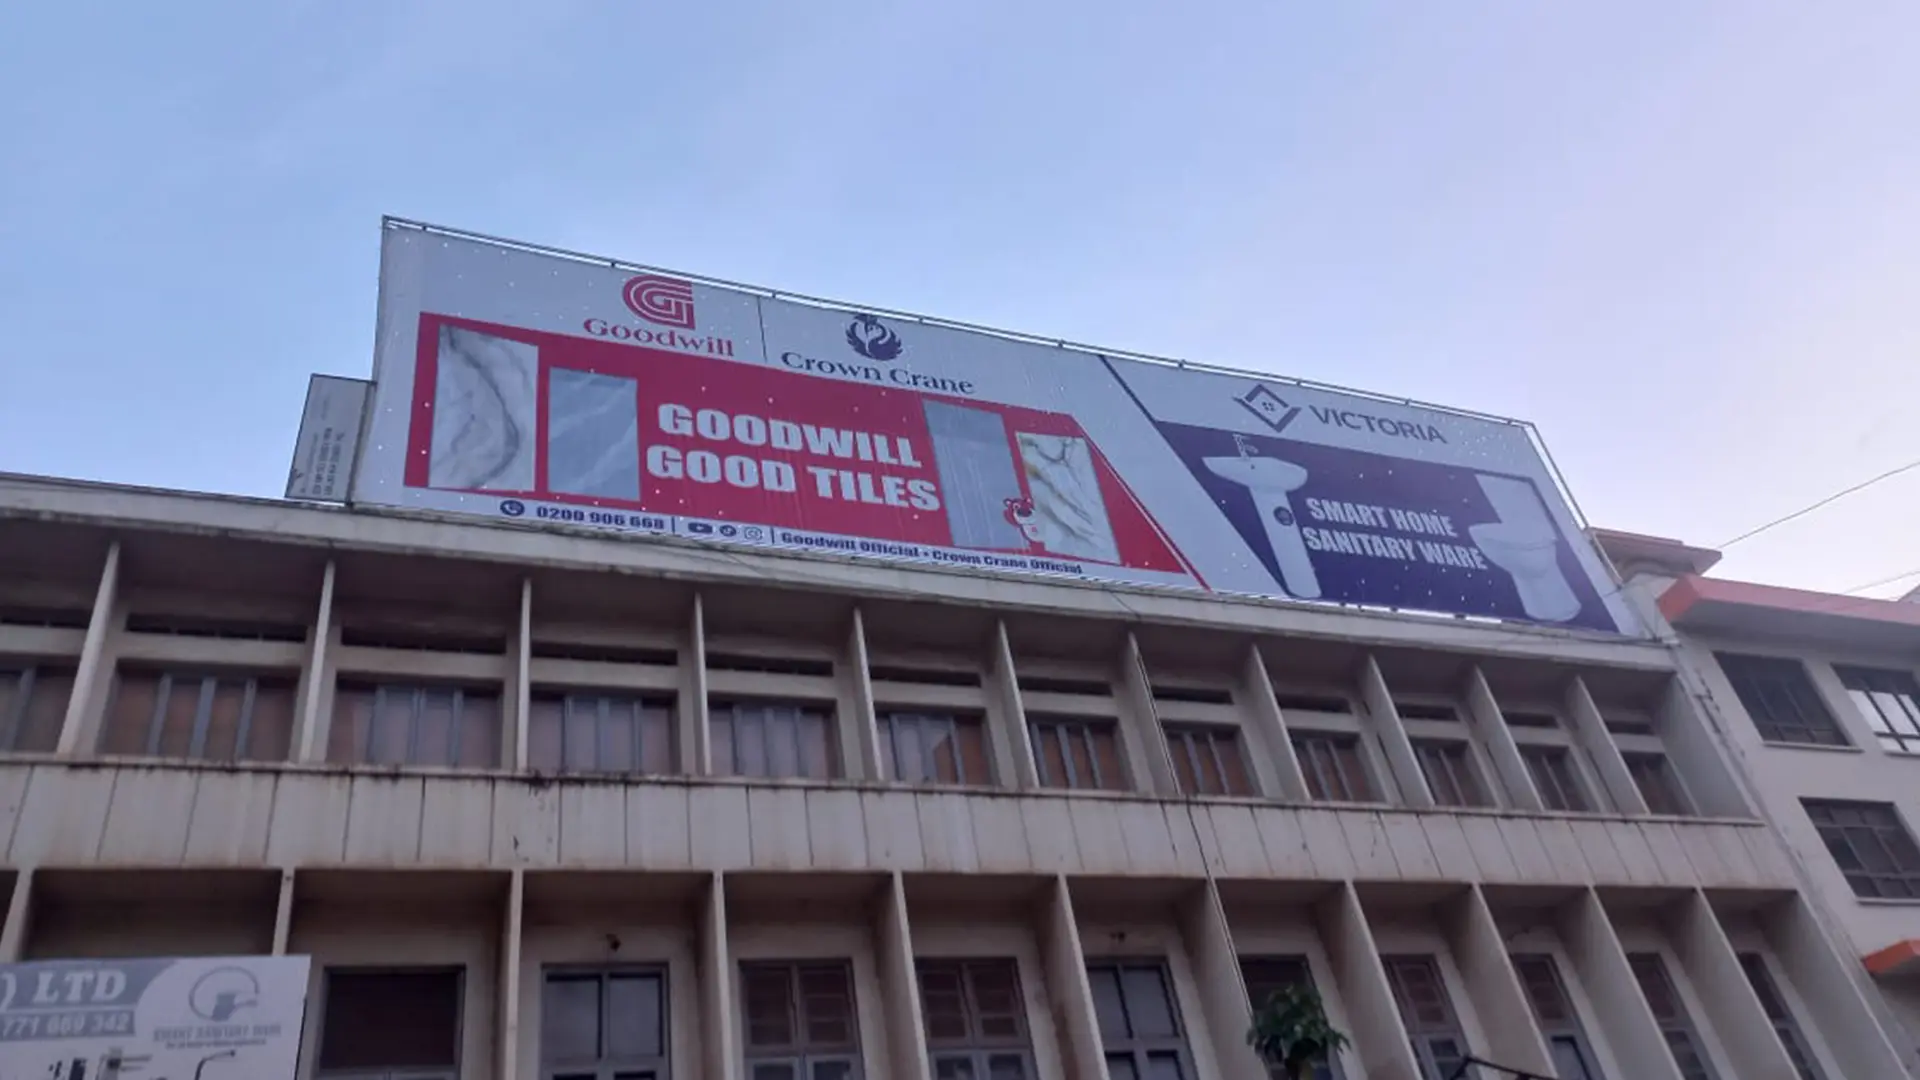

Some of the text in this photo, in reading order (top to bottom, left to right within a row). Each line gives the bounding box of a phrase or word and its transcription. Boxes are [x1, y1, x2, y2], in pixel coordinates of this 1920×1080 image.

[583, 318, 734, 357] Goodwill
[781, 352, 975, 394] Crown Crane
[658, 403, 922, 468] GOODWILL
[1308, 404, 1448, 444] VICTORIA
[647, 445, 941, 511] GOOD TILES
[590, 512, 625, 526] 906
[1306, 497, 1457, 537] SMART HOME
[781, 532, 1083, 575] Goodwill Official Crown Crane Official
[1302, 527, 1488, 570] SANITARY WARE
[32, 969, 126, 1003] LTD
